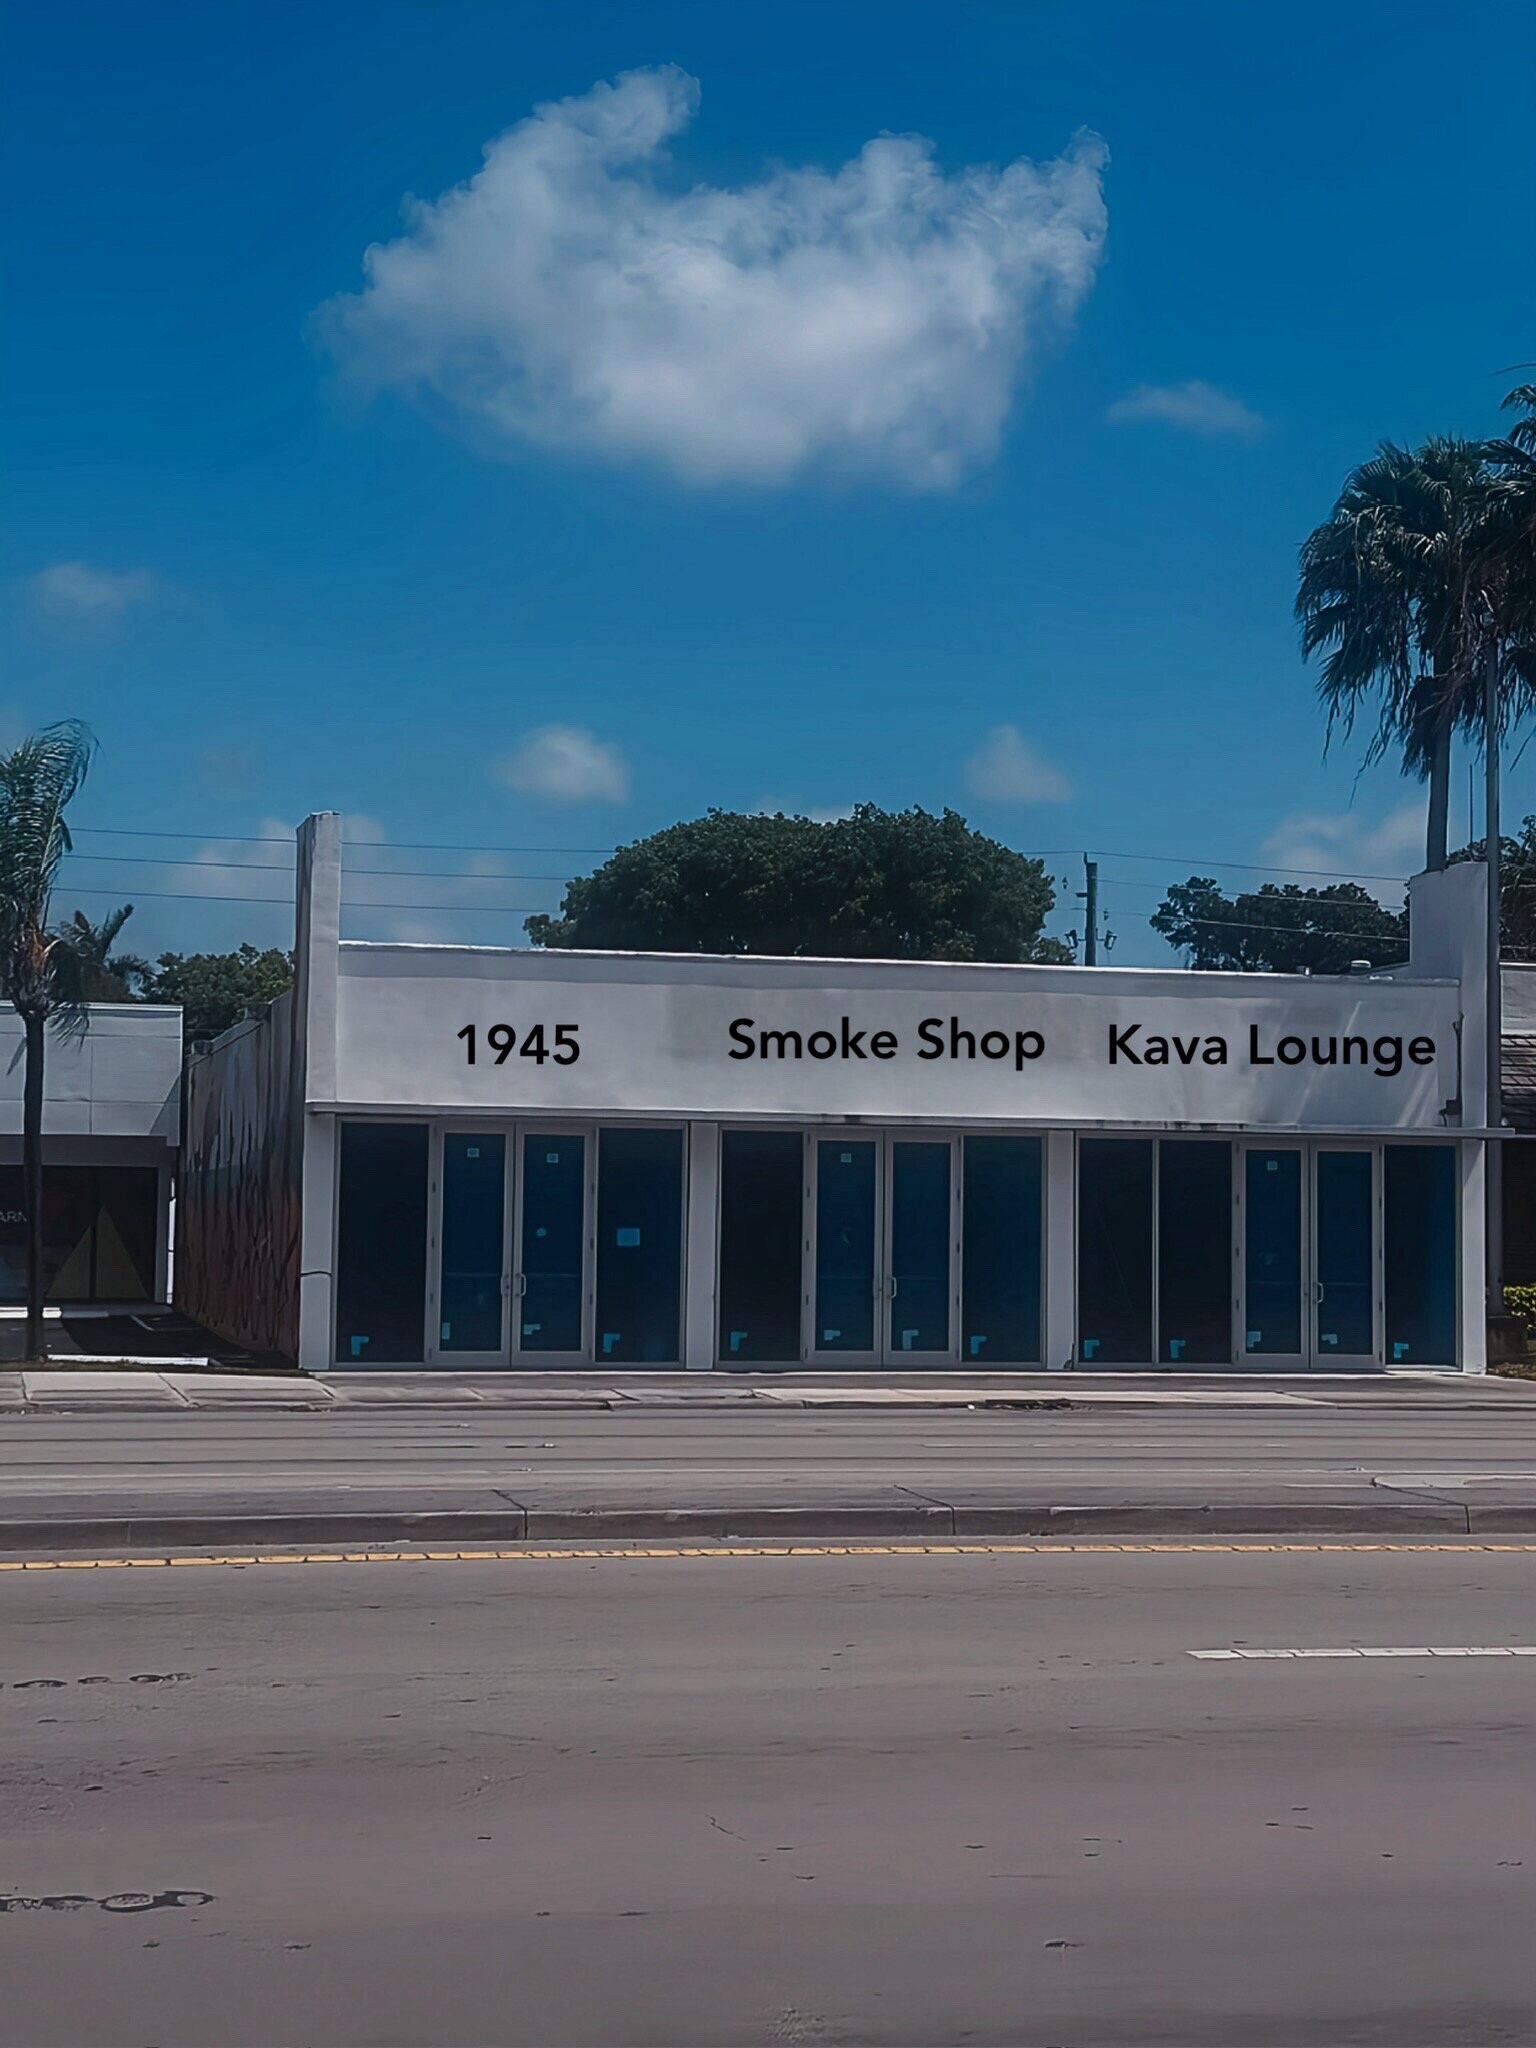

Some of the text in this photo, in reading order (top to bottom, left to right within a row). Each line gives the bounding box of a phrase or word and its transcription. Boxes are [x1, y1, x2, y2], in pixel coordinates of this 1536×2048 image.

[457, 1023, 580, 1066] 1945
[727, 1015, 1046, 1072] Smoke Shop
[1108, 1023, 1436, 1078] Kava Lounge
